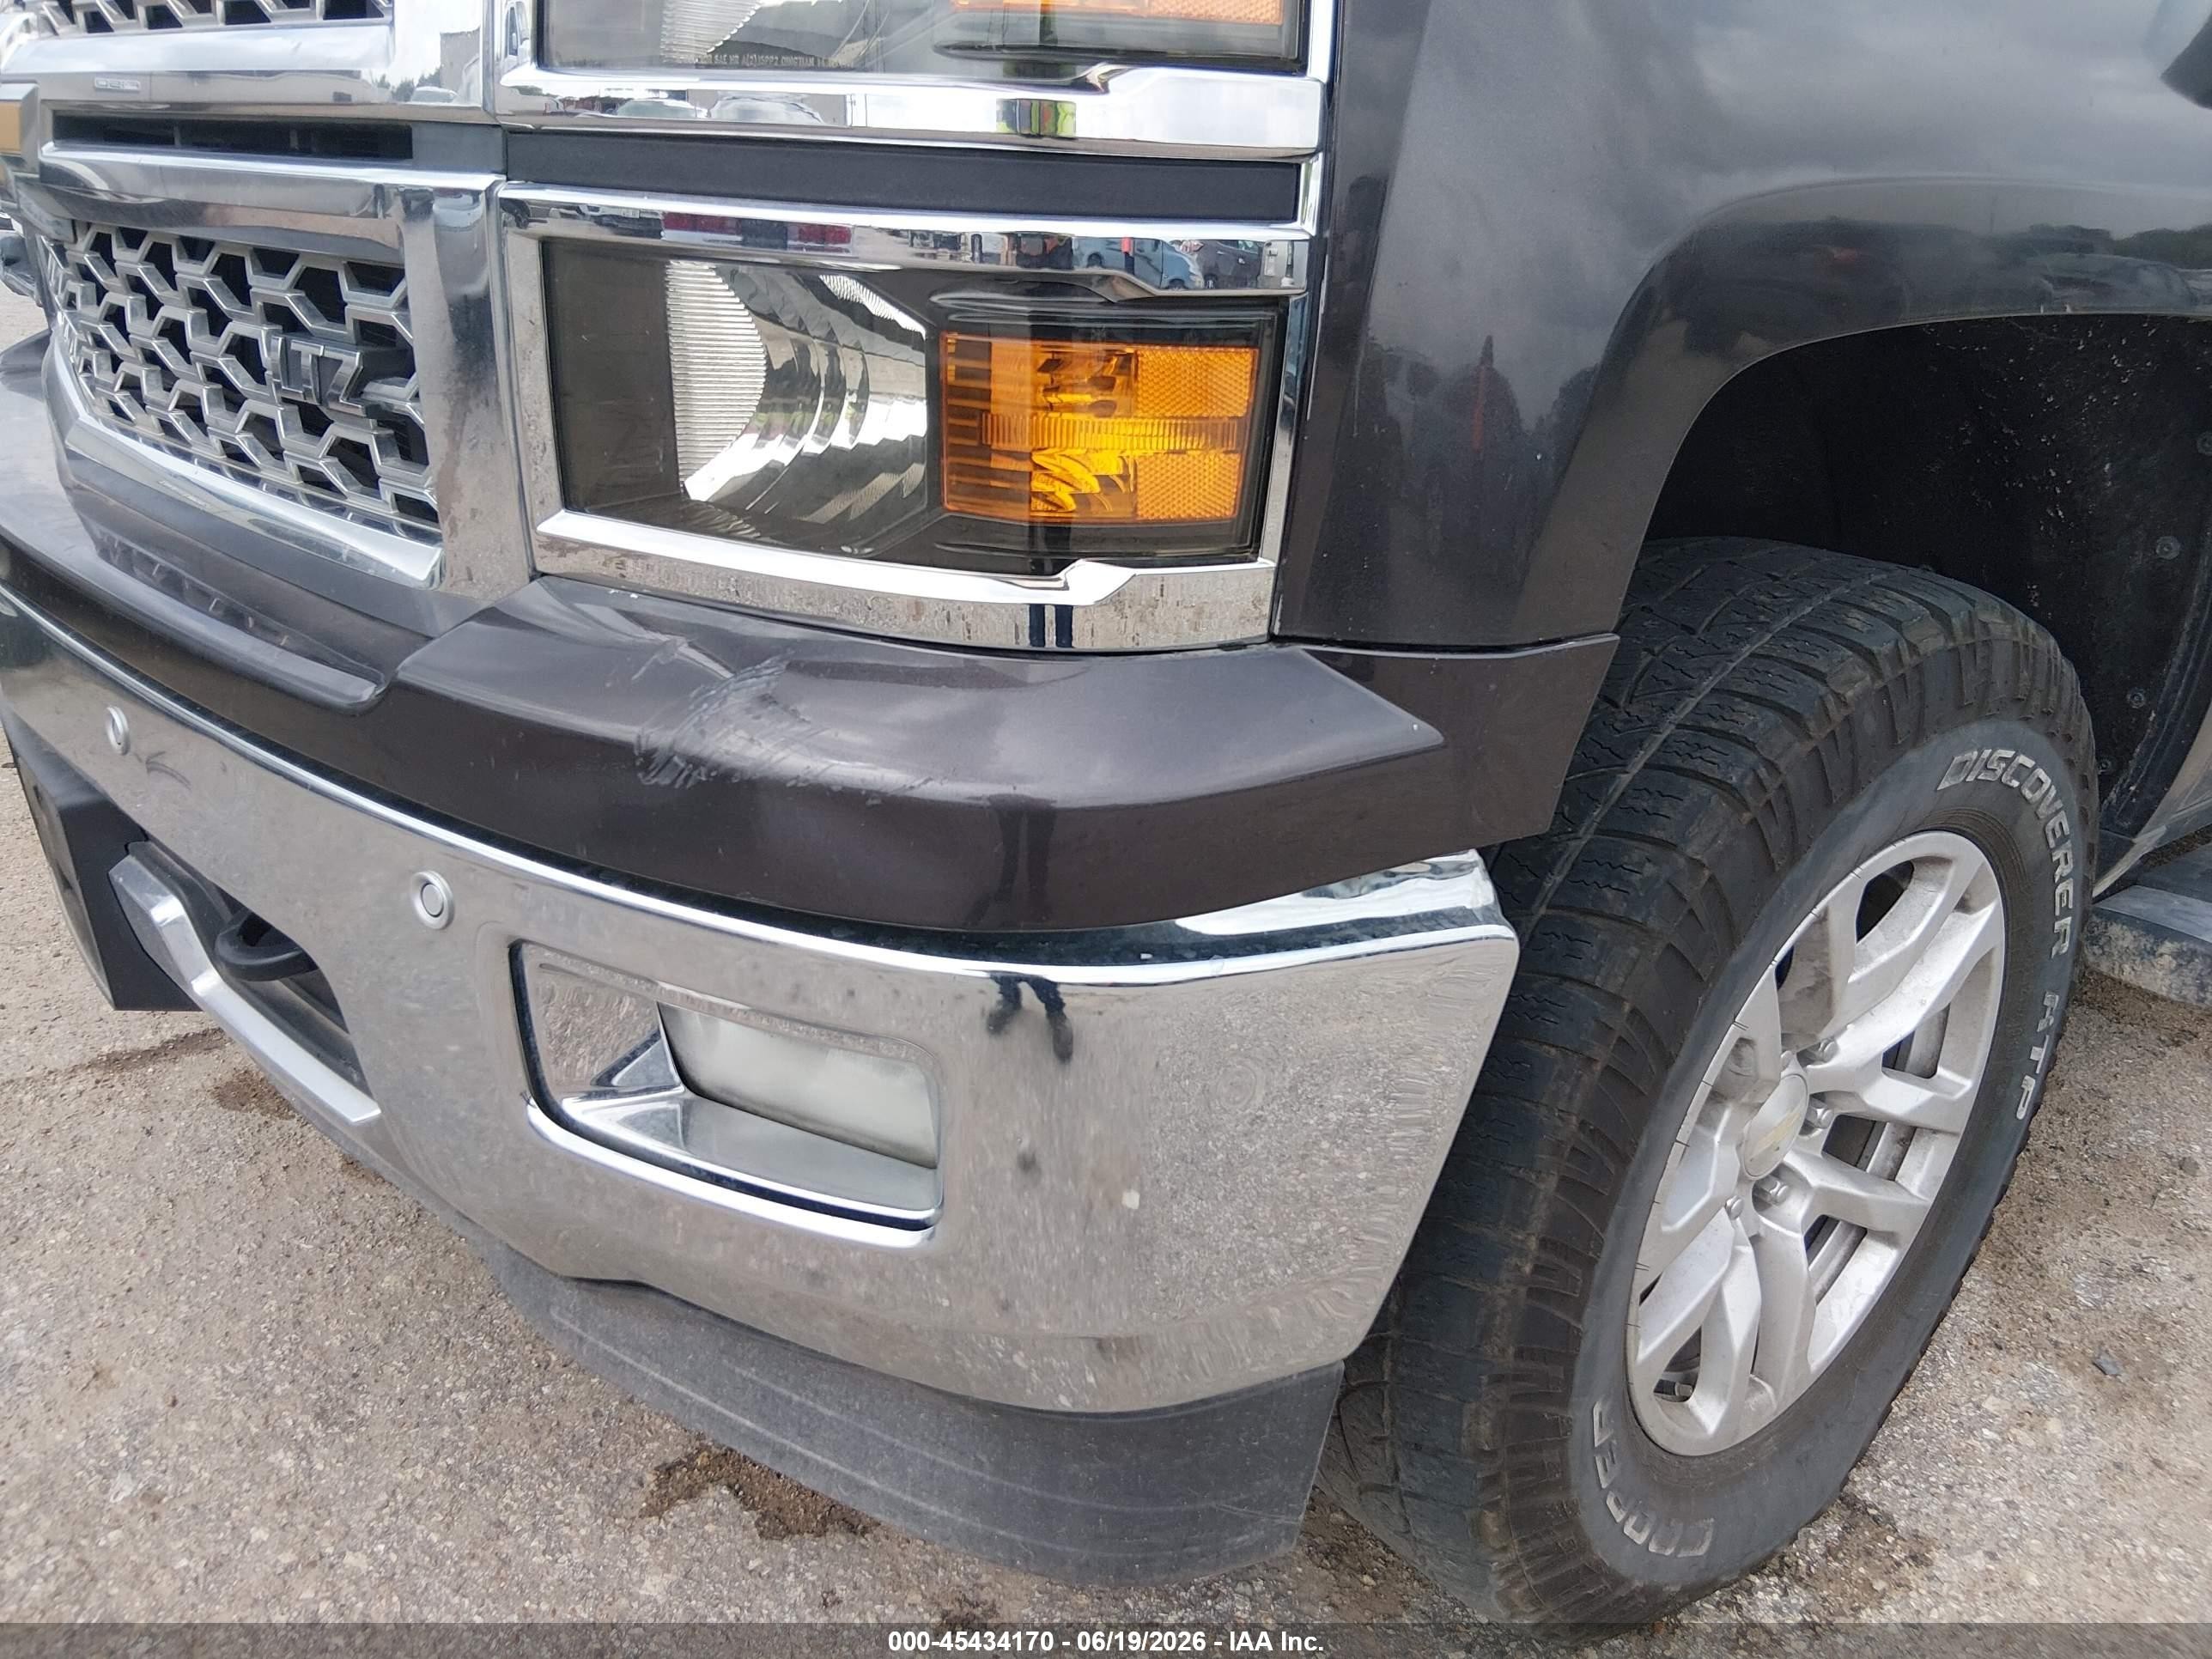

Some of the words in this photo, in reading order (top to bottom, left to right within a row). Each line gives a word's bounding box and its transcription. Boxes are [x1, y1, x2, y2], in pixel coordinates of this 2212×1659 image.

[270, 335, 368, 418] LTZ
[1936, 747, 2075, 960] DISCOVERER
[1592, 1401, 1715, 1559] COOPER
